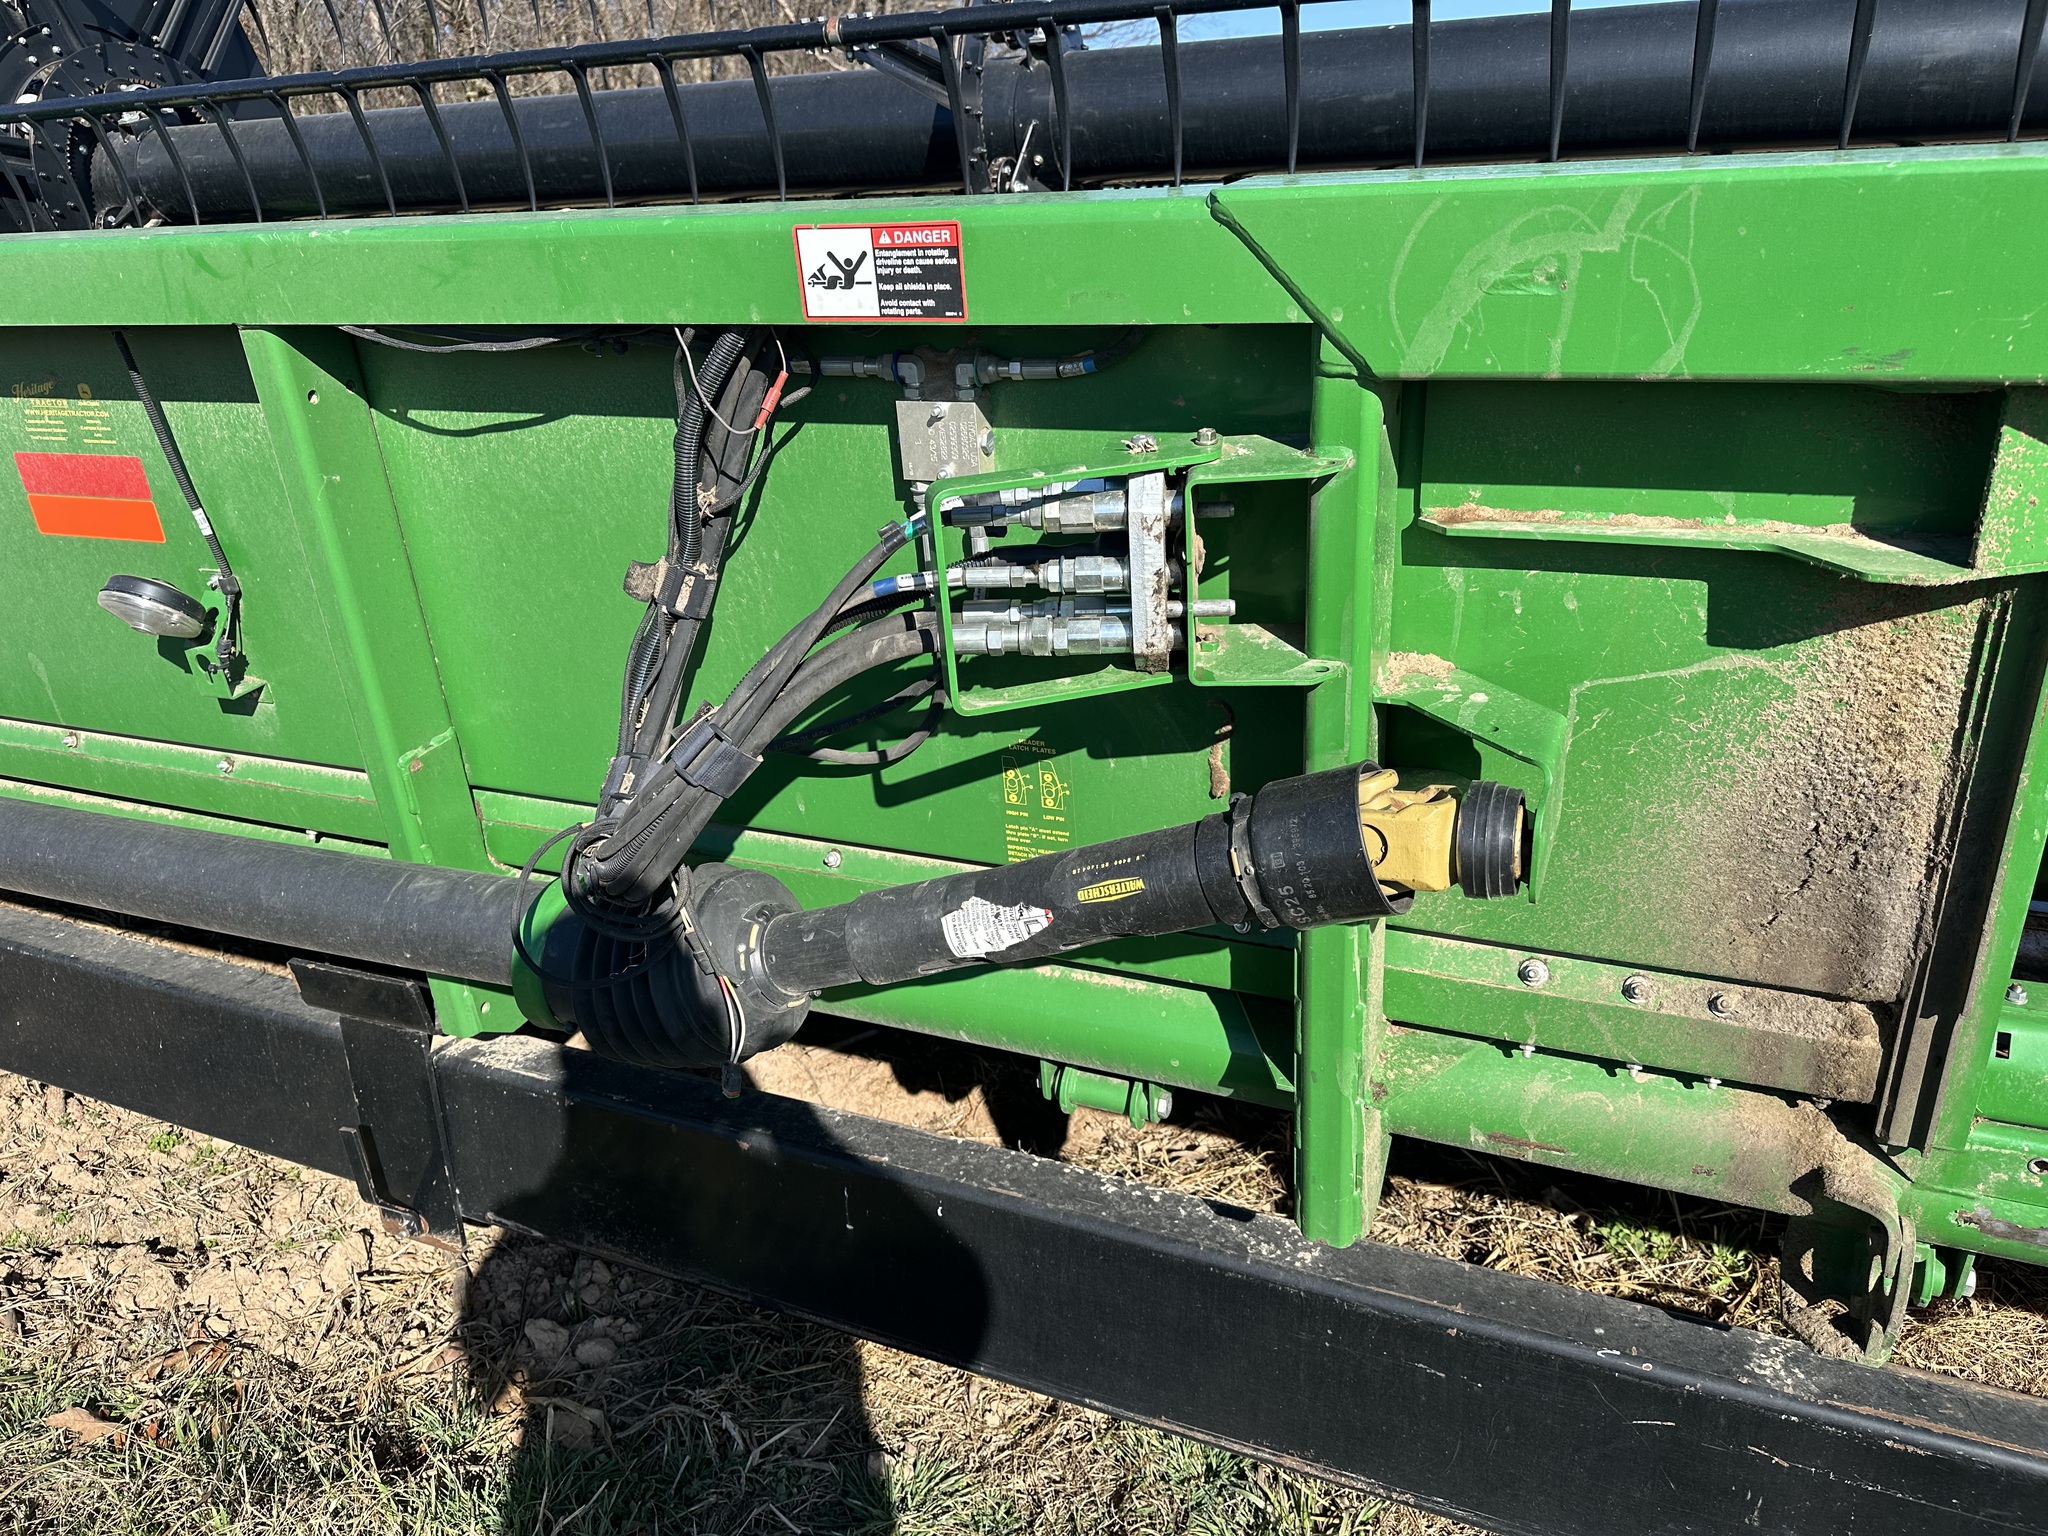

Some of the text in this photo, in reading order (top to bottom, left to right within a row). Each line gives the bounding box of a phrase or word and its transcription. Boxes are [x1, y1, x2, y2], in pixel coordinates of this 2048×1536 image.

[894, 230, 951, 244] DANGER
[875, 248, 917, 258] Entanglement
[925, 248, 949, 257] rotating
[876, 258, 902, 266] driveline
[934, 257, 957, 265] serious
[903, 266, 922, 274] death.
[879, 283, 893, 292] Keep
[904, 282, 926, 290] shields
[926, 282, 933, 290] in
[934, 282, 952, 292] place.
[880, 299, 935, 307] Avoid contact with
[881, 307, 923, 317] rotating parts.
[11, 381, 54, 403] Heritage
[968, 421, 976, 448] HYDAC
[1018, 738, 1045, 747] HEADER
[1009, 744, 1056, 755] LATCH PLATES
[1017, 830, 1030, 838] plate
[1052, 829, 1070, 837] extend
[1077, 878, 1146, 901] WALTERSCHEID
[1277, 885, 1312, 924] SC25
